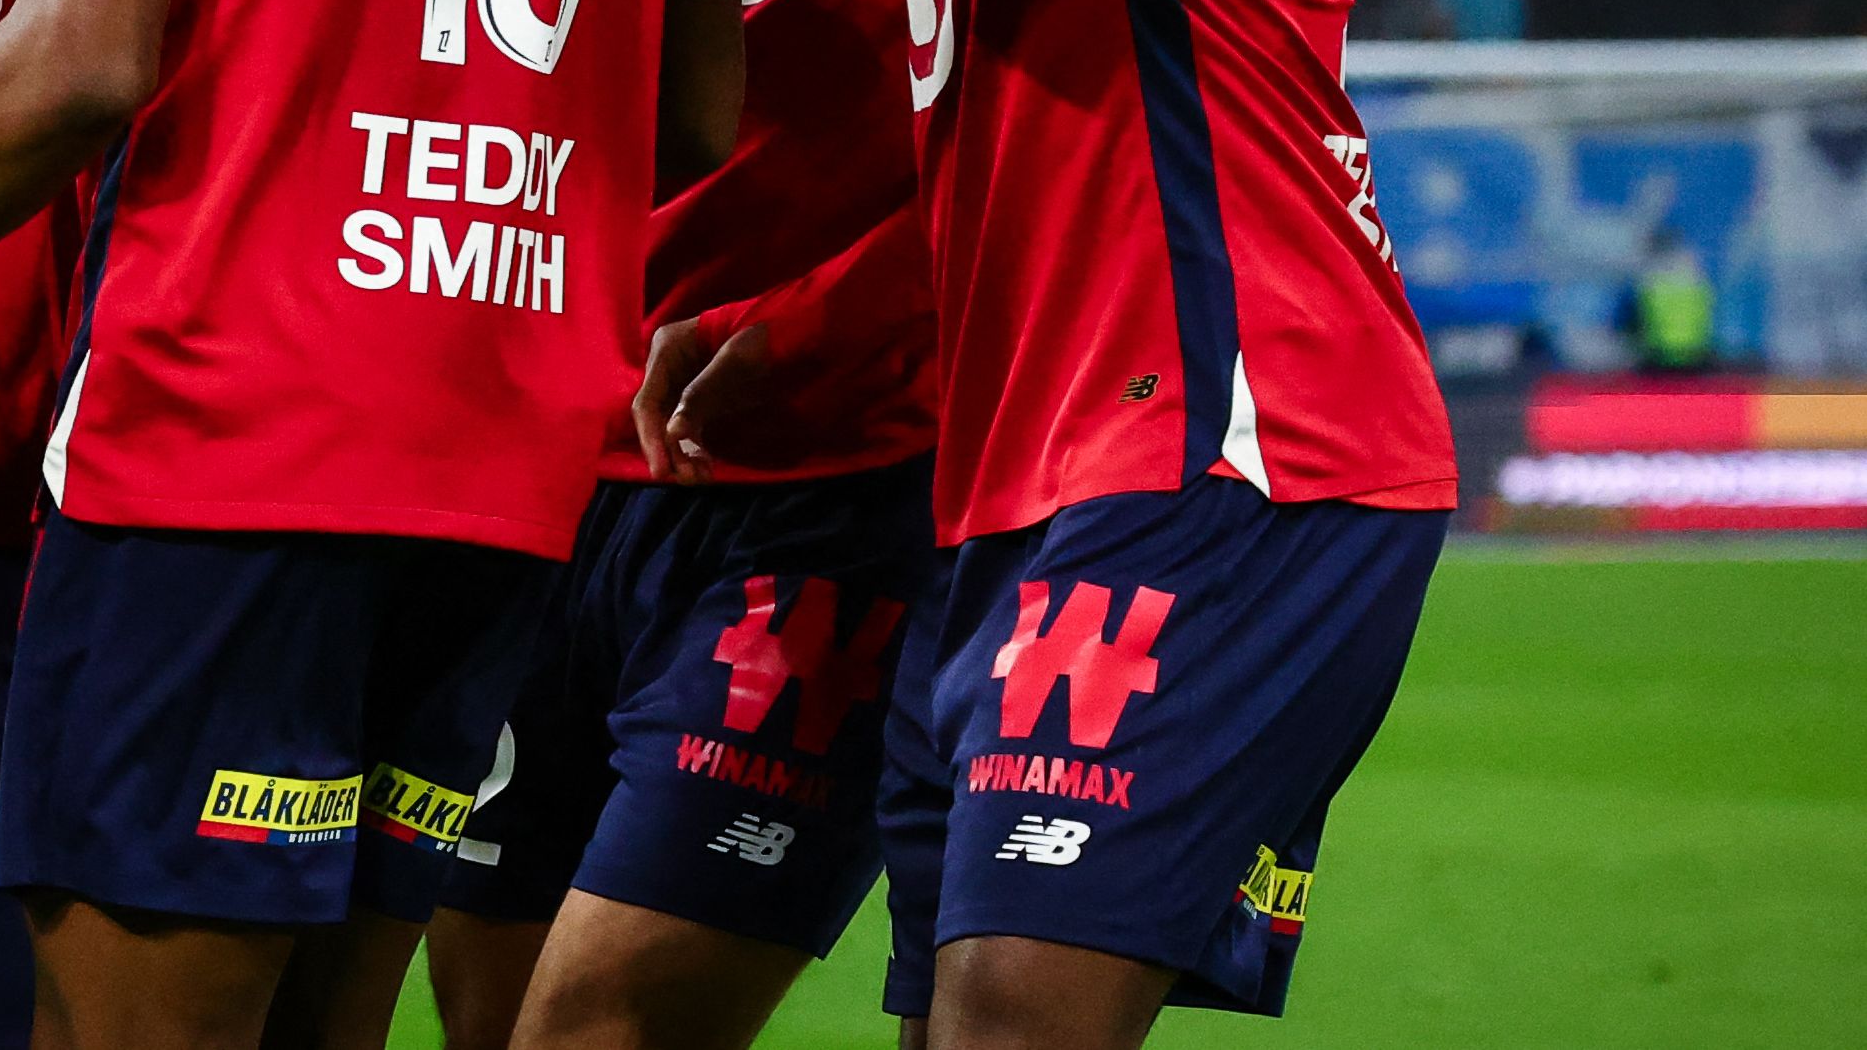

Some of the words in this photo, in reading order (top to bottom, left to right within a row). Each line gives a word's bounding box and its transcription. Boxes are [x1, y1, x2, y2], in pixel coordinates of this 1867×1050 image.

[350, 111, 576, 216] TEDDY
[337, 209, 565, 314] SMITH
[211, 779, 358, 826] BLÅKLÄDER
[968, 753, 1135, 811] WINAMAX
